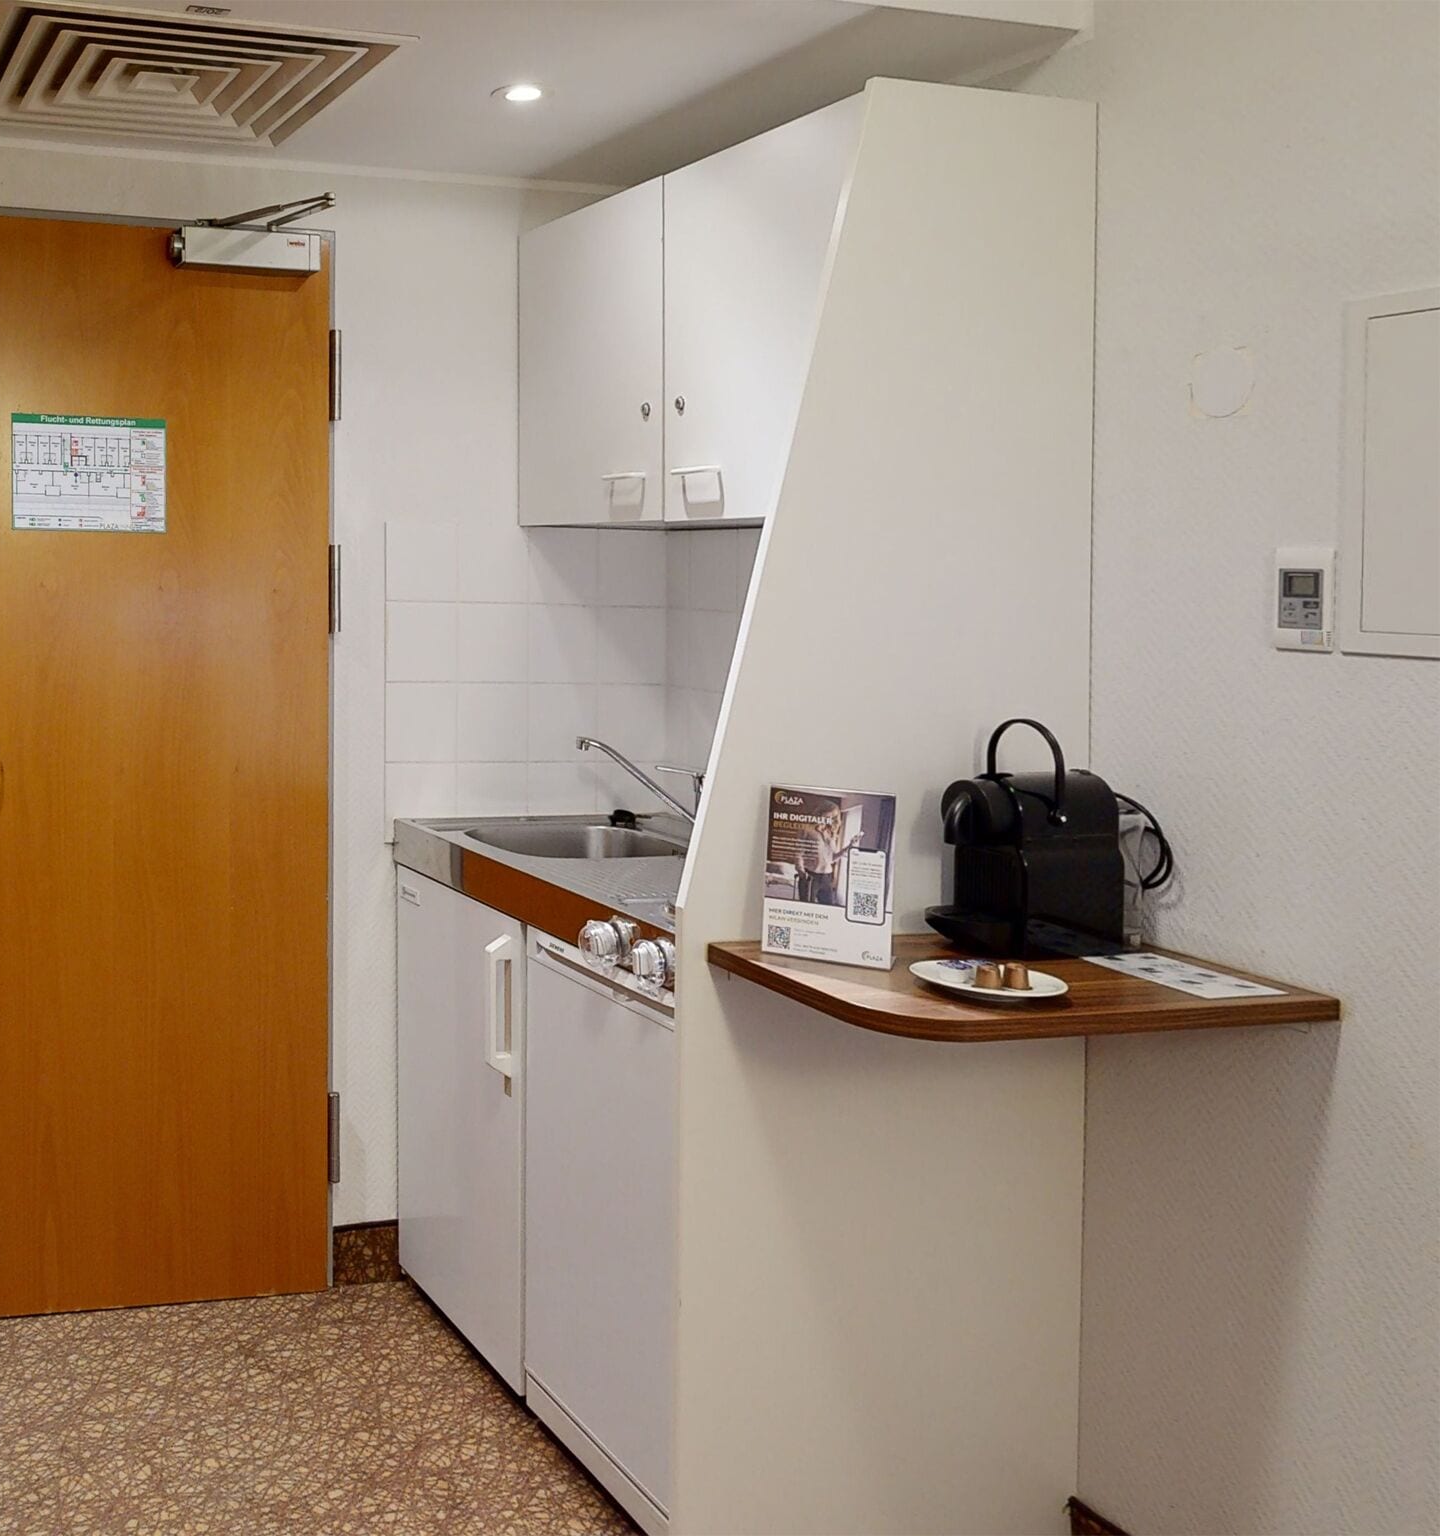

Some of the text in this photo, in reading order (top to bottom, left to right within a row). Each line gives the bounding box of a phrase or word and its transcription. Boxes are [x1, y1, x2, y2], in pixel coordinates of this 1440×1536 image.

[40, 415, 136, 427] Flucht- und Rettungsplan
[780, 795, 804, 804] PLAZA
[773, 812, 832, 825] IHR DIGITALER
